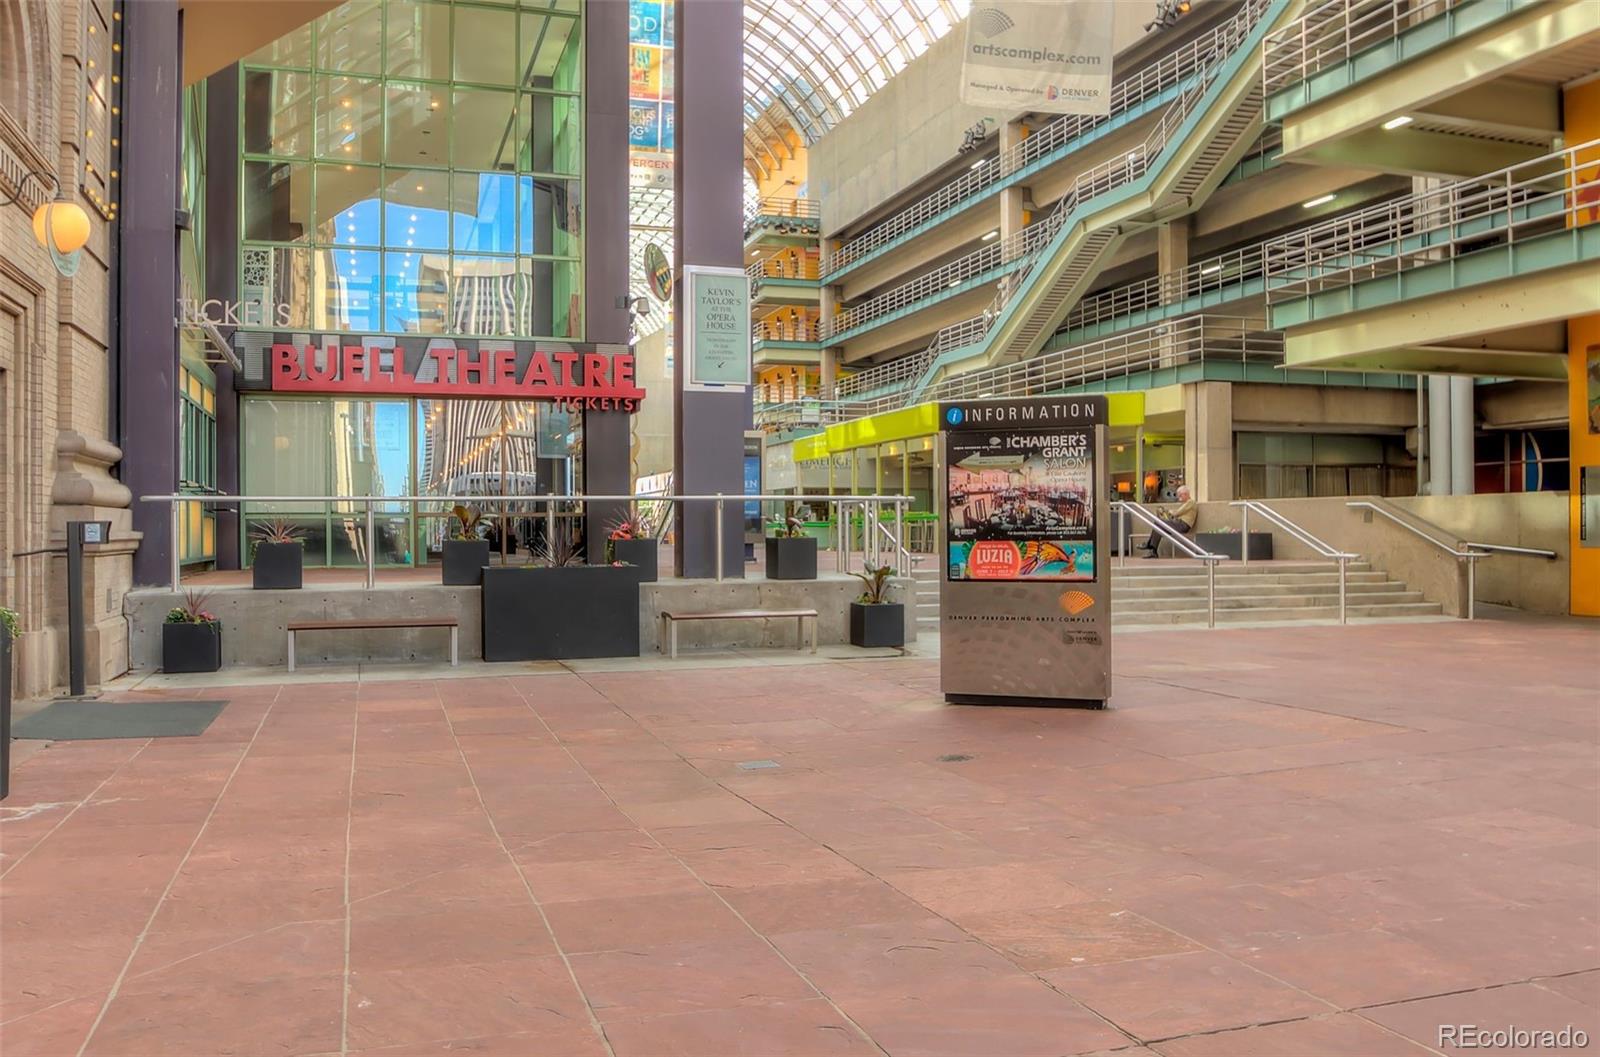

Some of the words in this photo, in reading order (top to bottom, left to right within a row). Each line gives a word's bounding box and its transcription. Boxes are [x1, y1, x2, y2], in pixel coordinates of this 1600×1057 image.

[972, 44, 1101, 65] artscomplex.com
[1061, 88, 1100, 97] DENVER
[707, 288, 735, 297] KEVIN
[701, 296, 742, 305] TAYLOR'S
[177, 298, 292, 328] TICKETS
[706, 312, 736, 322] OPERA
[706, 321, 736, 330] HOUSE
[271, 343, 414, 382] BUELL
[430, 348, 635, 390] THEATRE
[554, 397, 635, 412] TICKETS
[964, 403, 1095, 422] INFORMATION
[1011, 434, 1087, 449] CHAMBER'S
[1042, 446, 1087, 458] GRANT
[1044, 457, 1087, 470] SALON
[976, 549, 1012, 565] LUZIA
